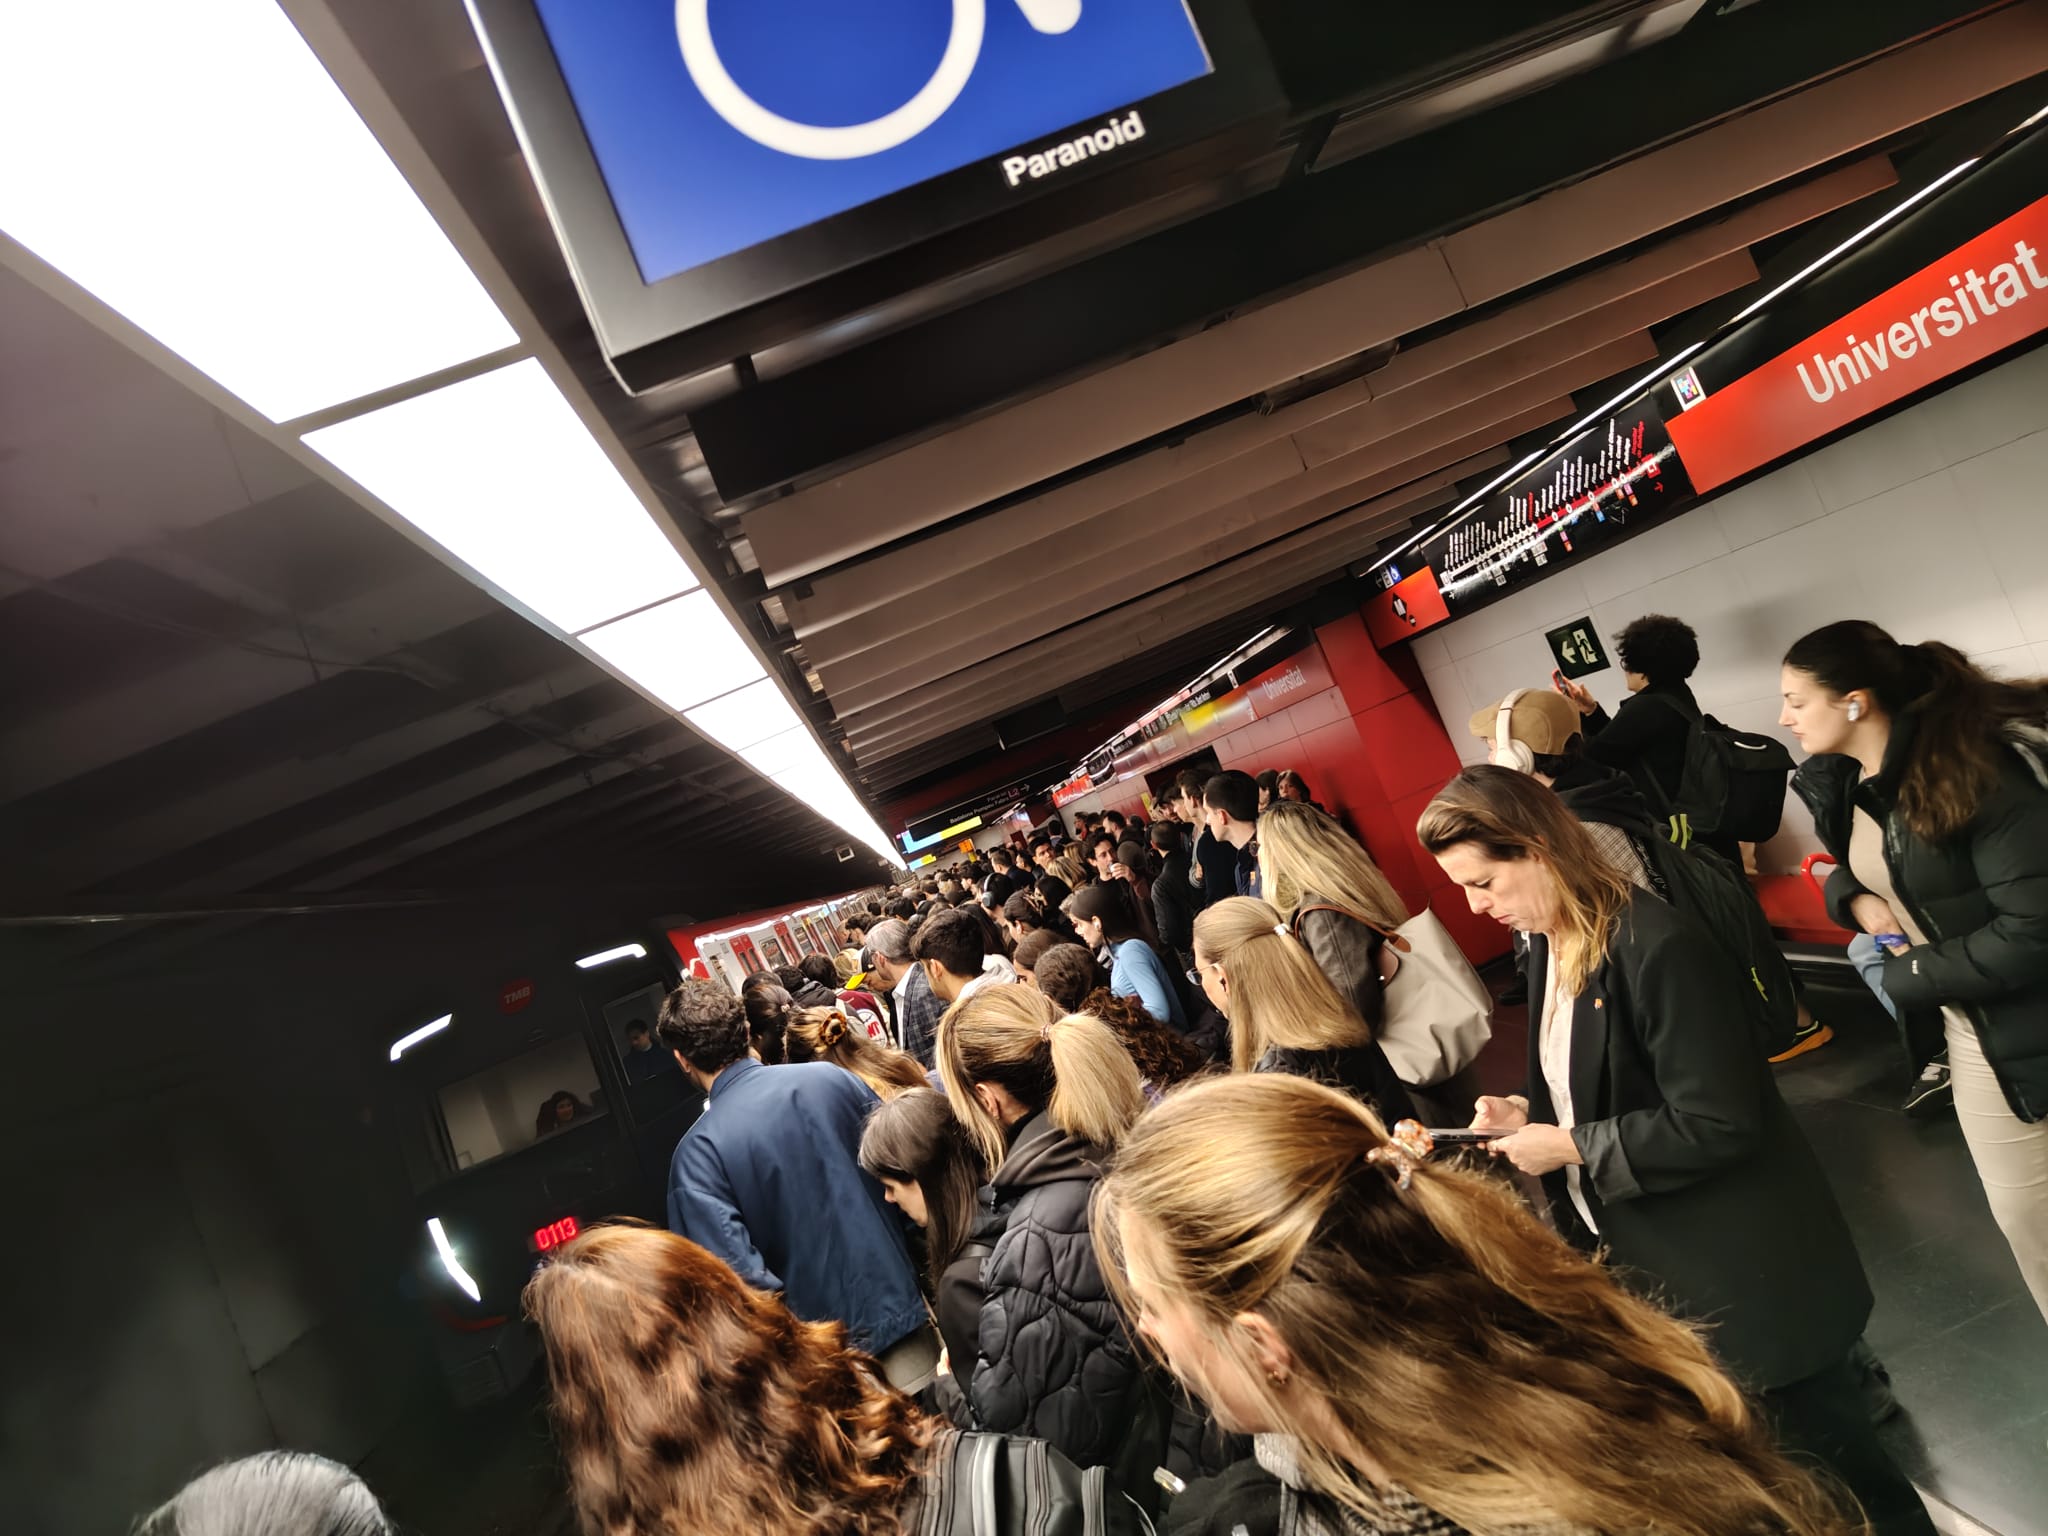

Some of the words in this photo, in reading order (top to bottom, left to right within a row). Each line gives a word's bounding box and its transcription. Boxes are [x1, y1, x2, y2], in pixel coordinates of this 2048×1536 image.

[1002, 110, 1146, 186] Paranoid
[1796, 240, 2048, 403] Universitat
[1261, 665, 1306, 700] Universitat
[504, 986, 530, 1005] TMB
[535, 1216, 577, 1249] 0113
